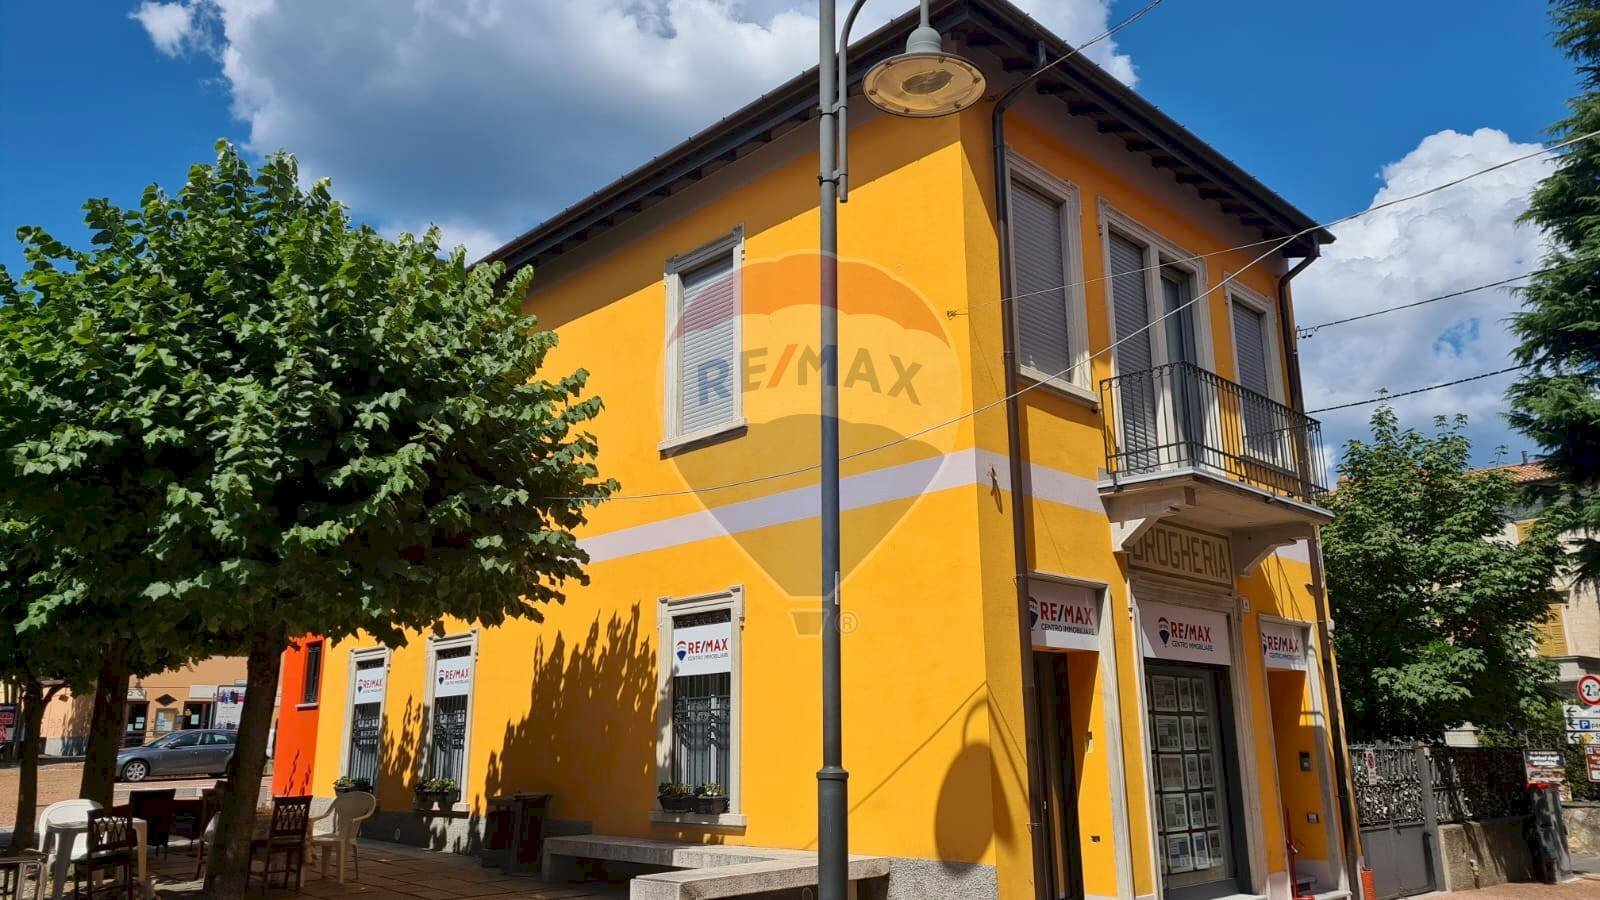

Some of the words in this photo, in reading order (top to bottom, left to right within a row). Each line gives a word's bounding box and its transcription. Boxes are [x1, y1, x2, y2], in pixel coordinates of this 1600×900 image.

[1040, 601, 1094, 626] RE/MAX
[1041, 623, 1063, 632] CENTRO
[1170, 621, 1212, 643] RE/MAX
[688, 638, 729, 655] RE/MAX
[1267, 635, 1299, 653] RE/MAX
[445, 668, 470, 680] RE/MAX
